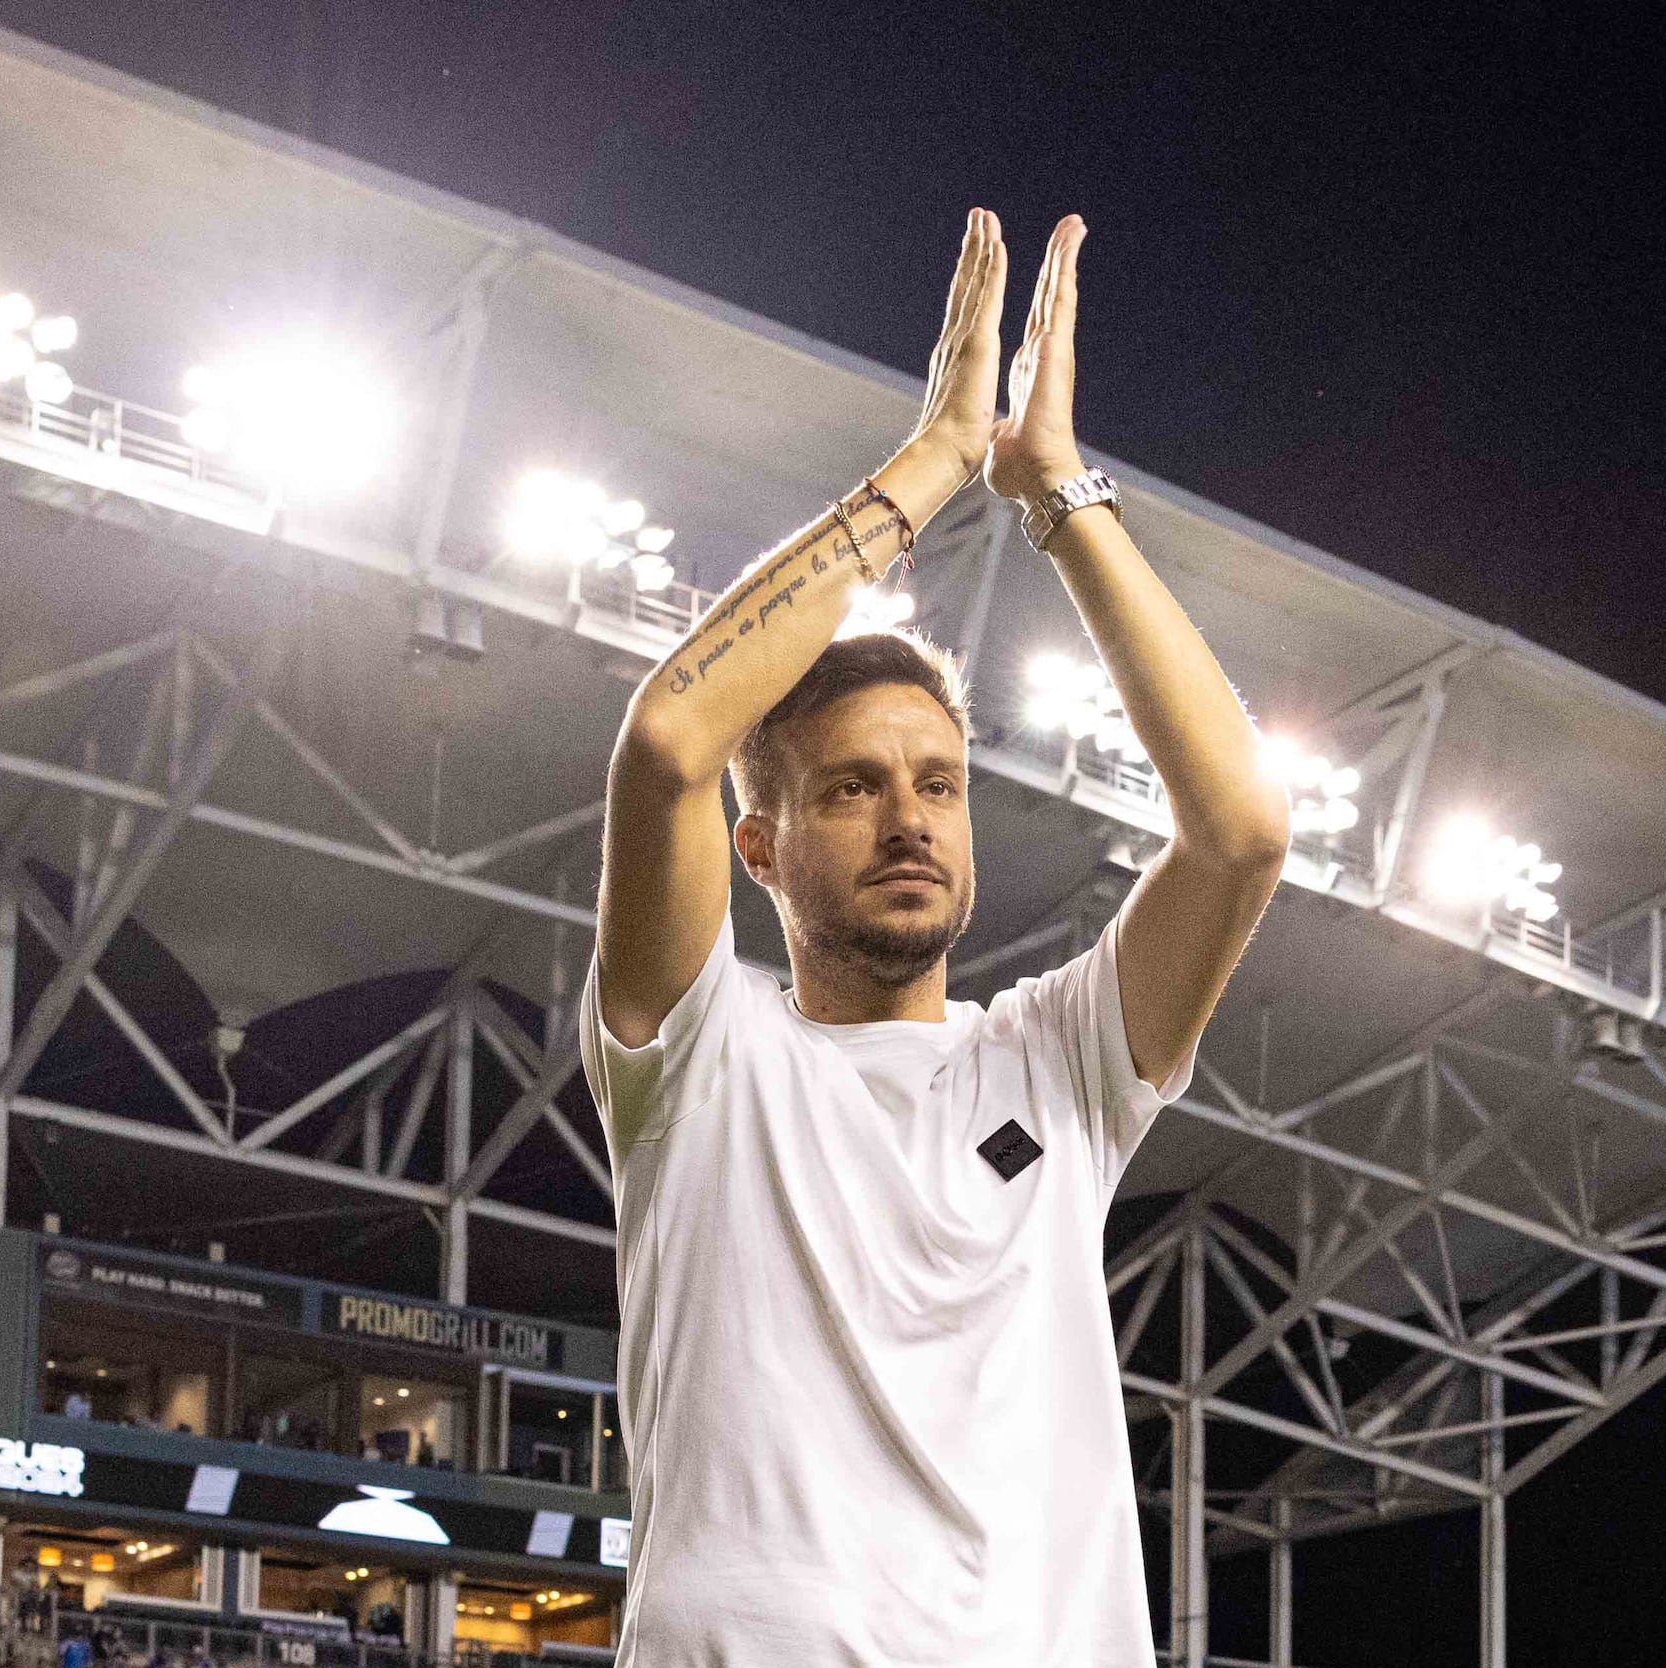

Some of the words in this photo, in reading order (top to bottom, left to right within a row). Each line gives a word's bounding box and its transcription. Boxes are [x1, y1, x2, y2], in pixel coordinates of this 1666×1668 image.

[759, 576, 805, 628] porque
[811, 554, 826, 574] lo
[341, 1295, 548, 1361] PROMOGRILL.COM
